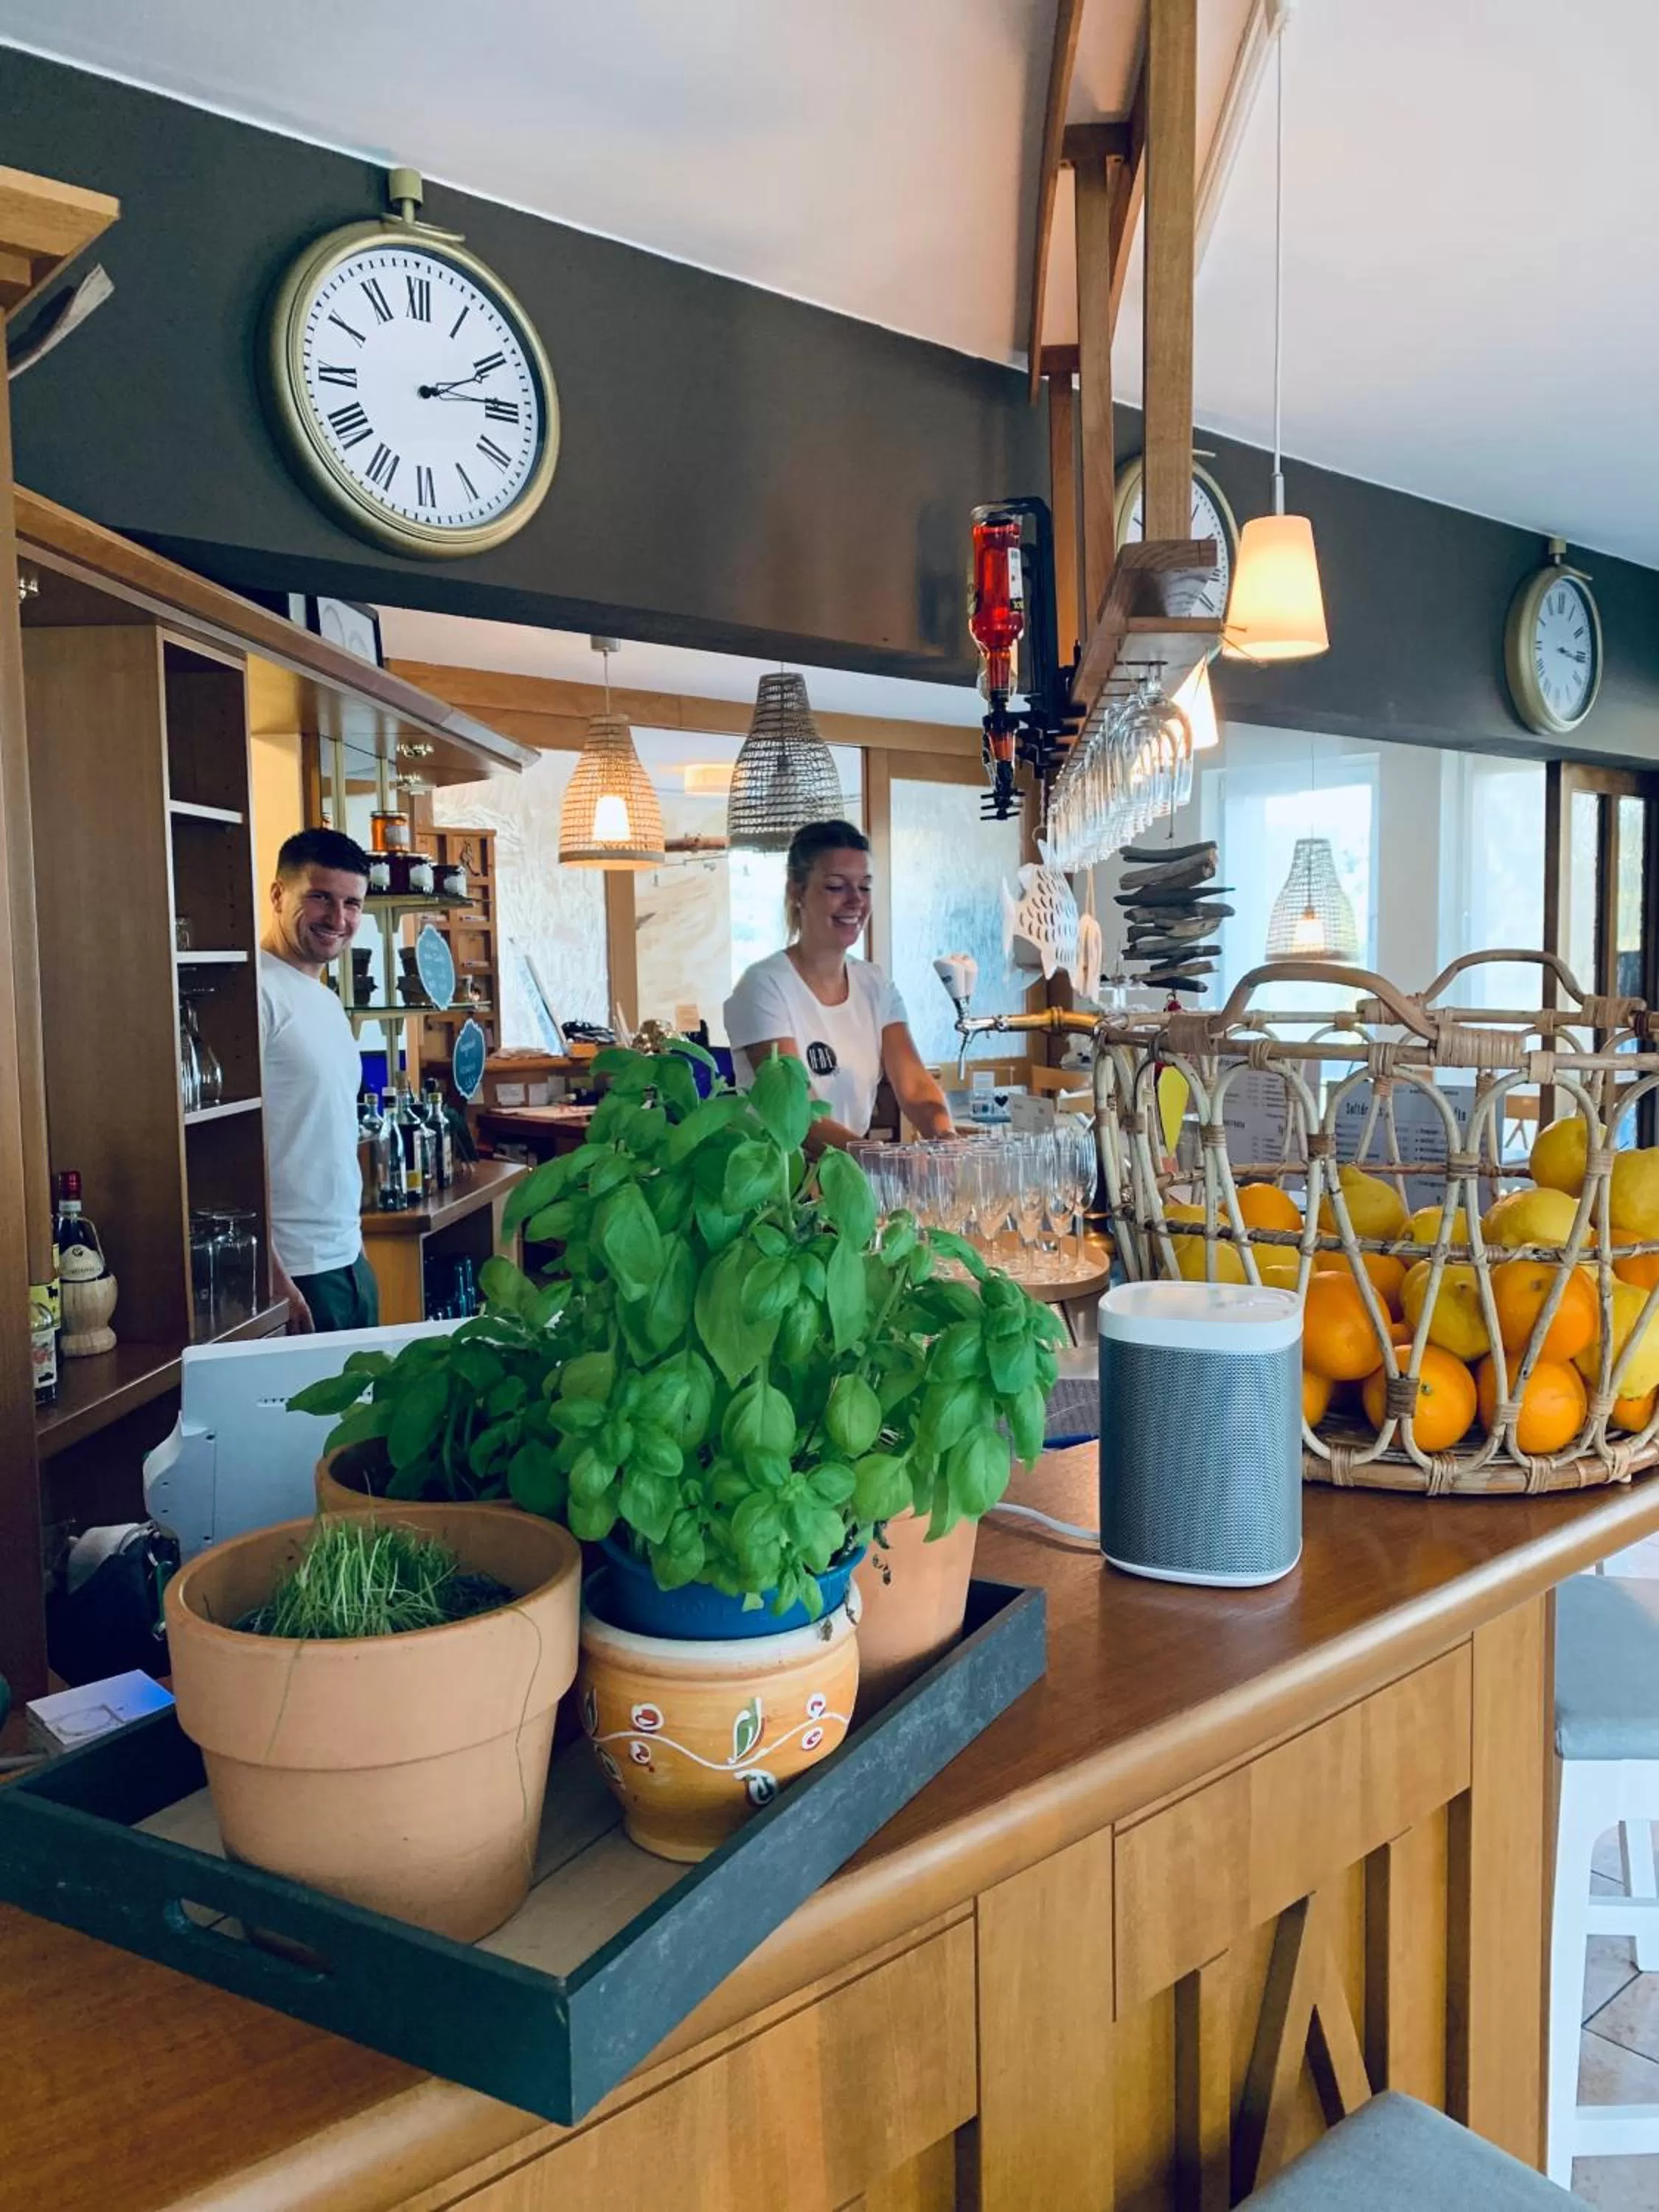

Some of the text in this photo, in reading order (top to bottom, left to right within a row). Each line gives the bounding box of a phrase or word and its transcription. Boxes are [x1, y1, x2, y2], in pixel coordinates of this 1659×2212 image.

[360, 277, 394, 325] XI
[406, 275, 431, 322] XII
[327, 310, 366, 348] X
[449, 306, 470, 339] I
[318, 360, 358, 389] IX
[473, 351, 507, 375] II
[327, 401, 374, 451] VIII
[484, 397, 519, 424] III
[365, 442, 400, 493] VII
[416, 465, 437, 508] VI
[455, 462, 480, 503] V
